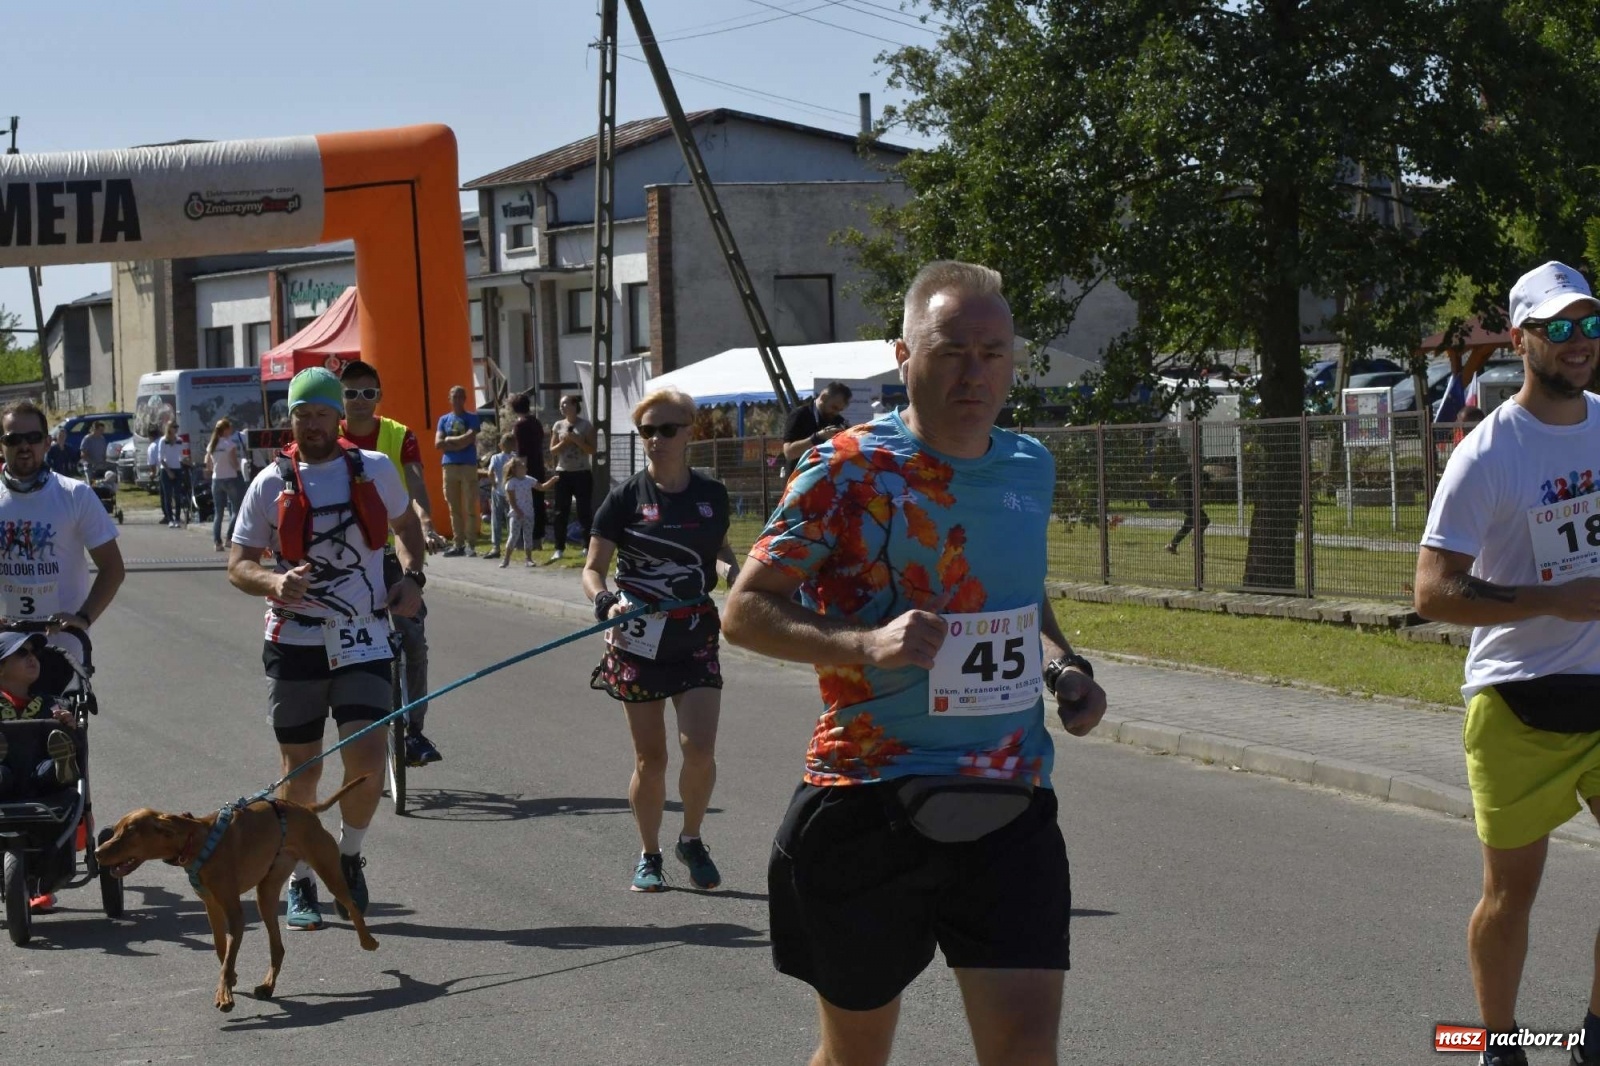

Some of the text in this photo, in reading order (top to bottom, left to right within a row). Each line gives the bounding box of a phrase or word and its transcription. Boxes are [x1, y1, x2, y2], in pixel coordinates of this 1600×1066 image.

[0, 179, 142, 247] META
[205, 197, 299, 215] Zmierzymy.pl
[1536, 501, 1589, 524] COLOUR
[1557, 513, 1600, 553] 18
[38, 561, 59, 575] RUN
[20, 596, 35, 614] 3
[950, 611, 1035, 637] OLOUR RUN
[339, 627, 373, 649] 54
[961, 636, 1026, 682] 45
